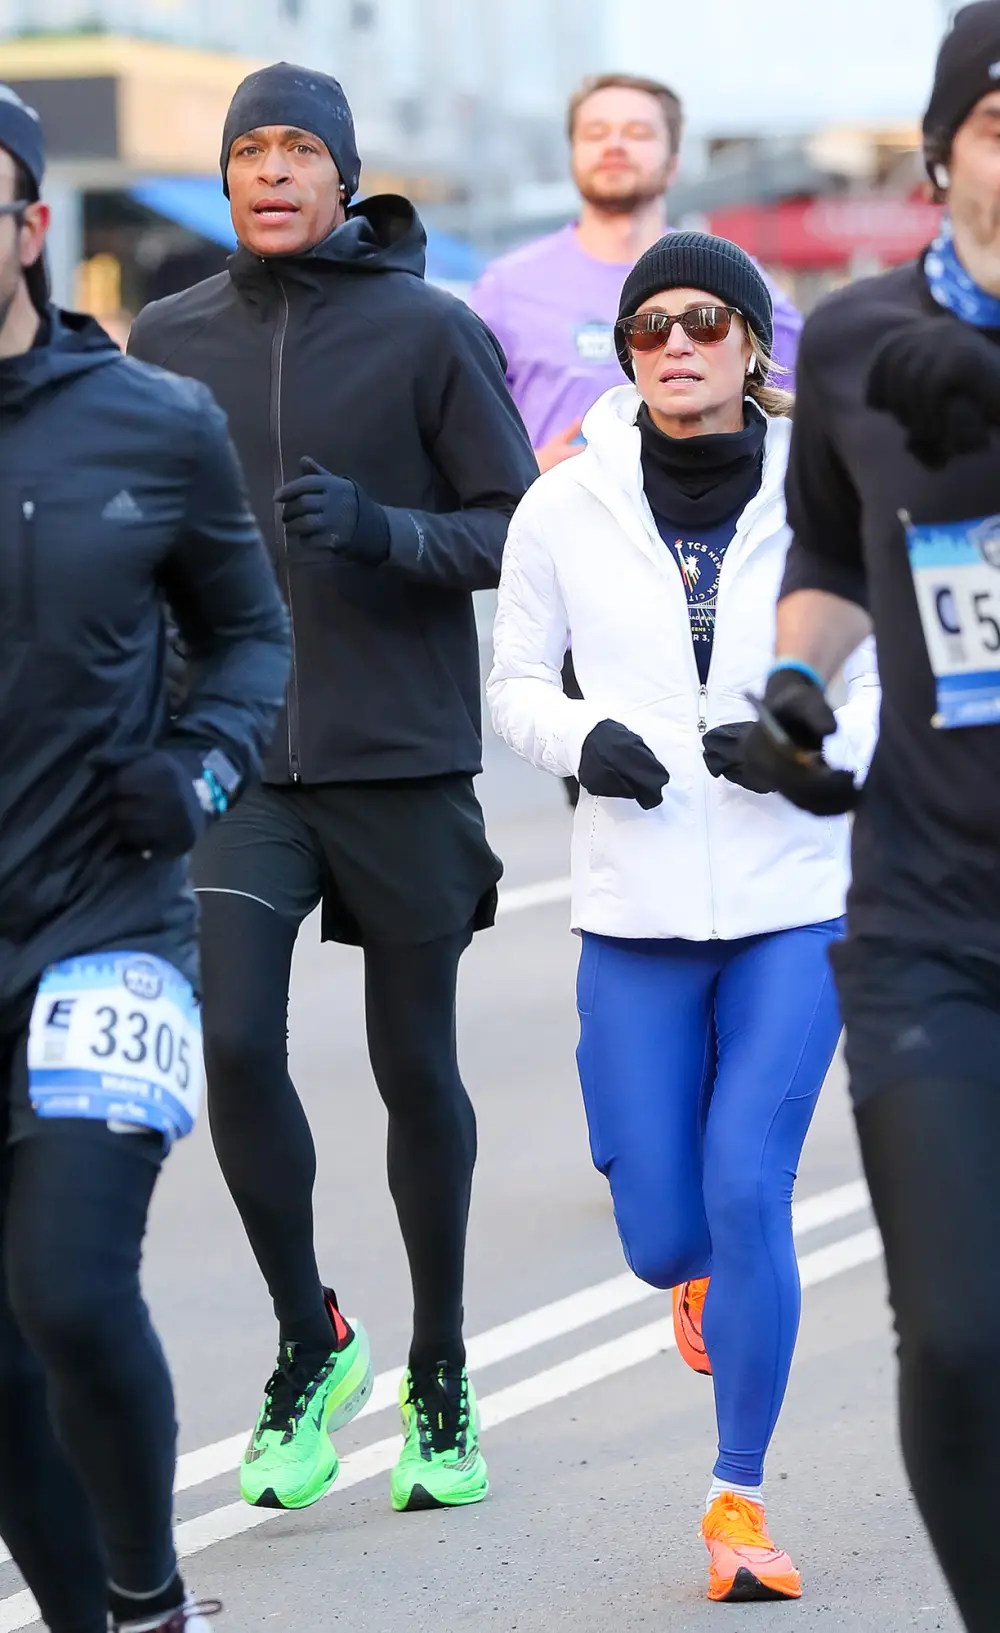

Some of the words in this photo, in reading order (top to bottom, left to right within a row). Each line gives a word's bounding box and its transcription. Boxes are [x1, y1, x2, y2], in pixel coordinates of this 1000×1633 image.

[687, 541, 708, 553] TCS
[708, 550, 722, 570] NEW
[688, 593, 706, 602] CIT
[935, 587, 961, 635] C
[46, 998, 78, 1030] E
[90, 1005, 190, 1091] 3305
